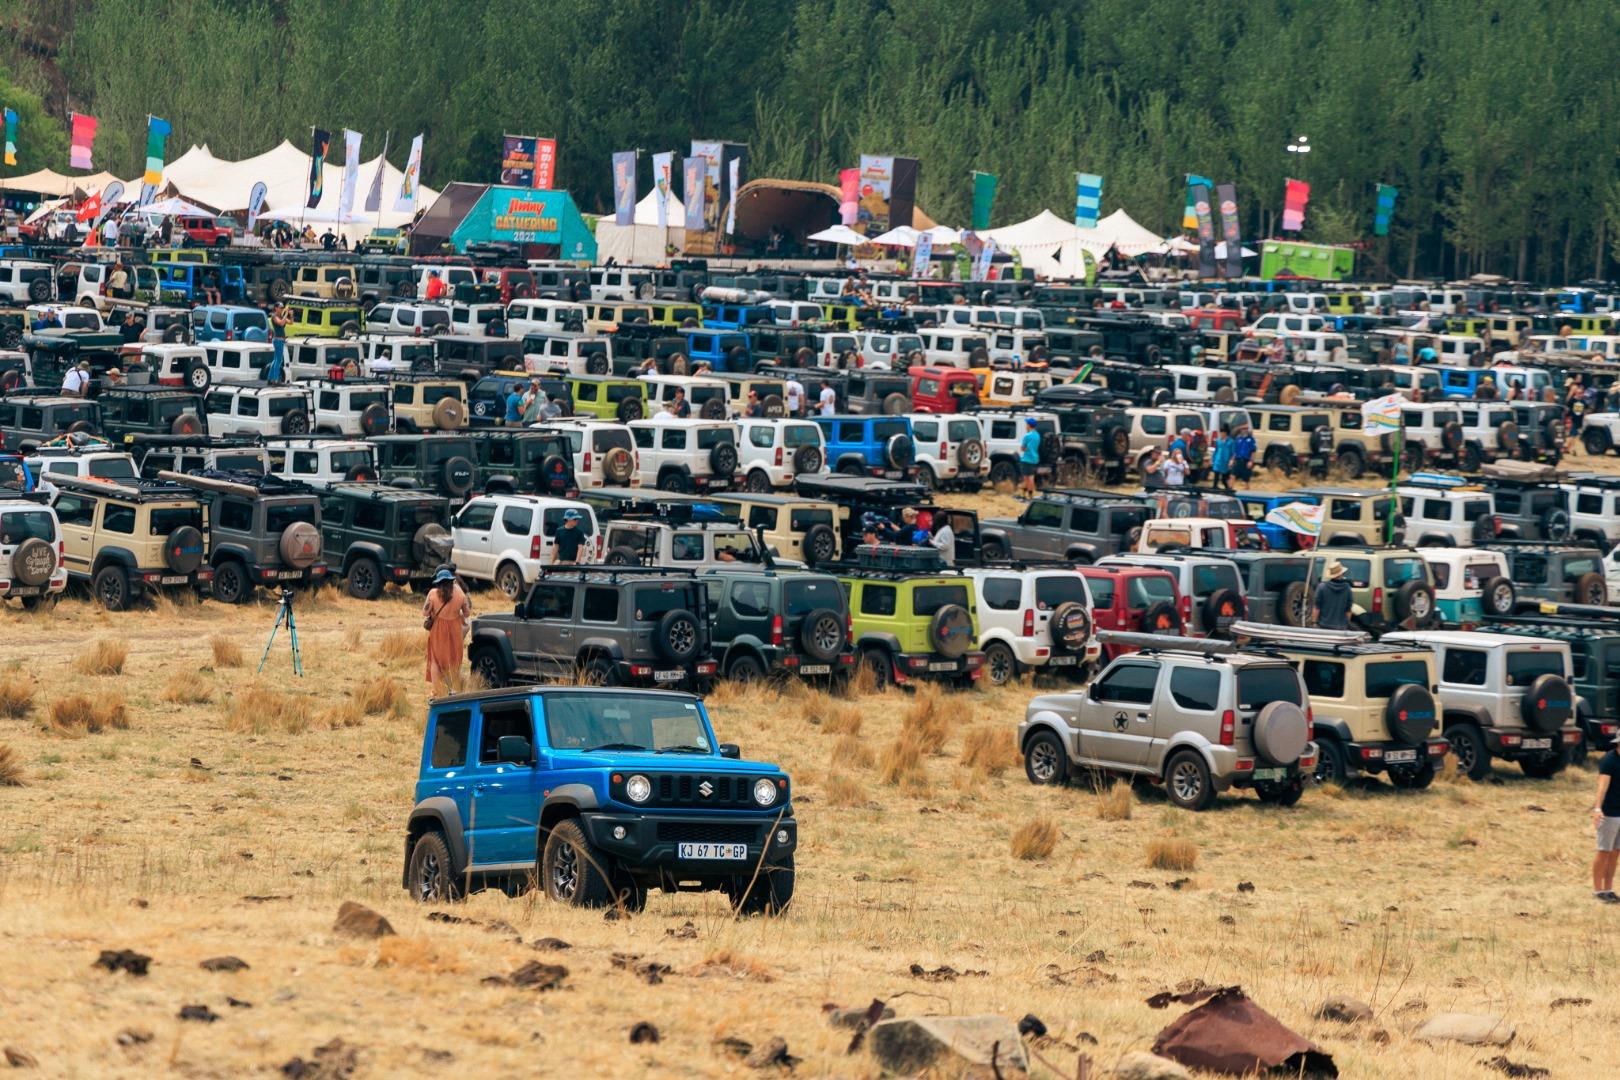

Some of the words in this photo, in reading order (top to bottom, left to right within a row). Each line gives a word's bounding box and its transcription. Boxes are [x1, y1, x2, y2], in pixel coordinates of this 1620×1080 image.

[496, 215, 557, 231] GATHERING
[514, 232, 536, 242] 2023
[681, 844, 694, 857] KJ
[697, 845, 710, 858] 67
[714, 845, 725, 858] TC
[733, 846, 746, 859] GP
